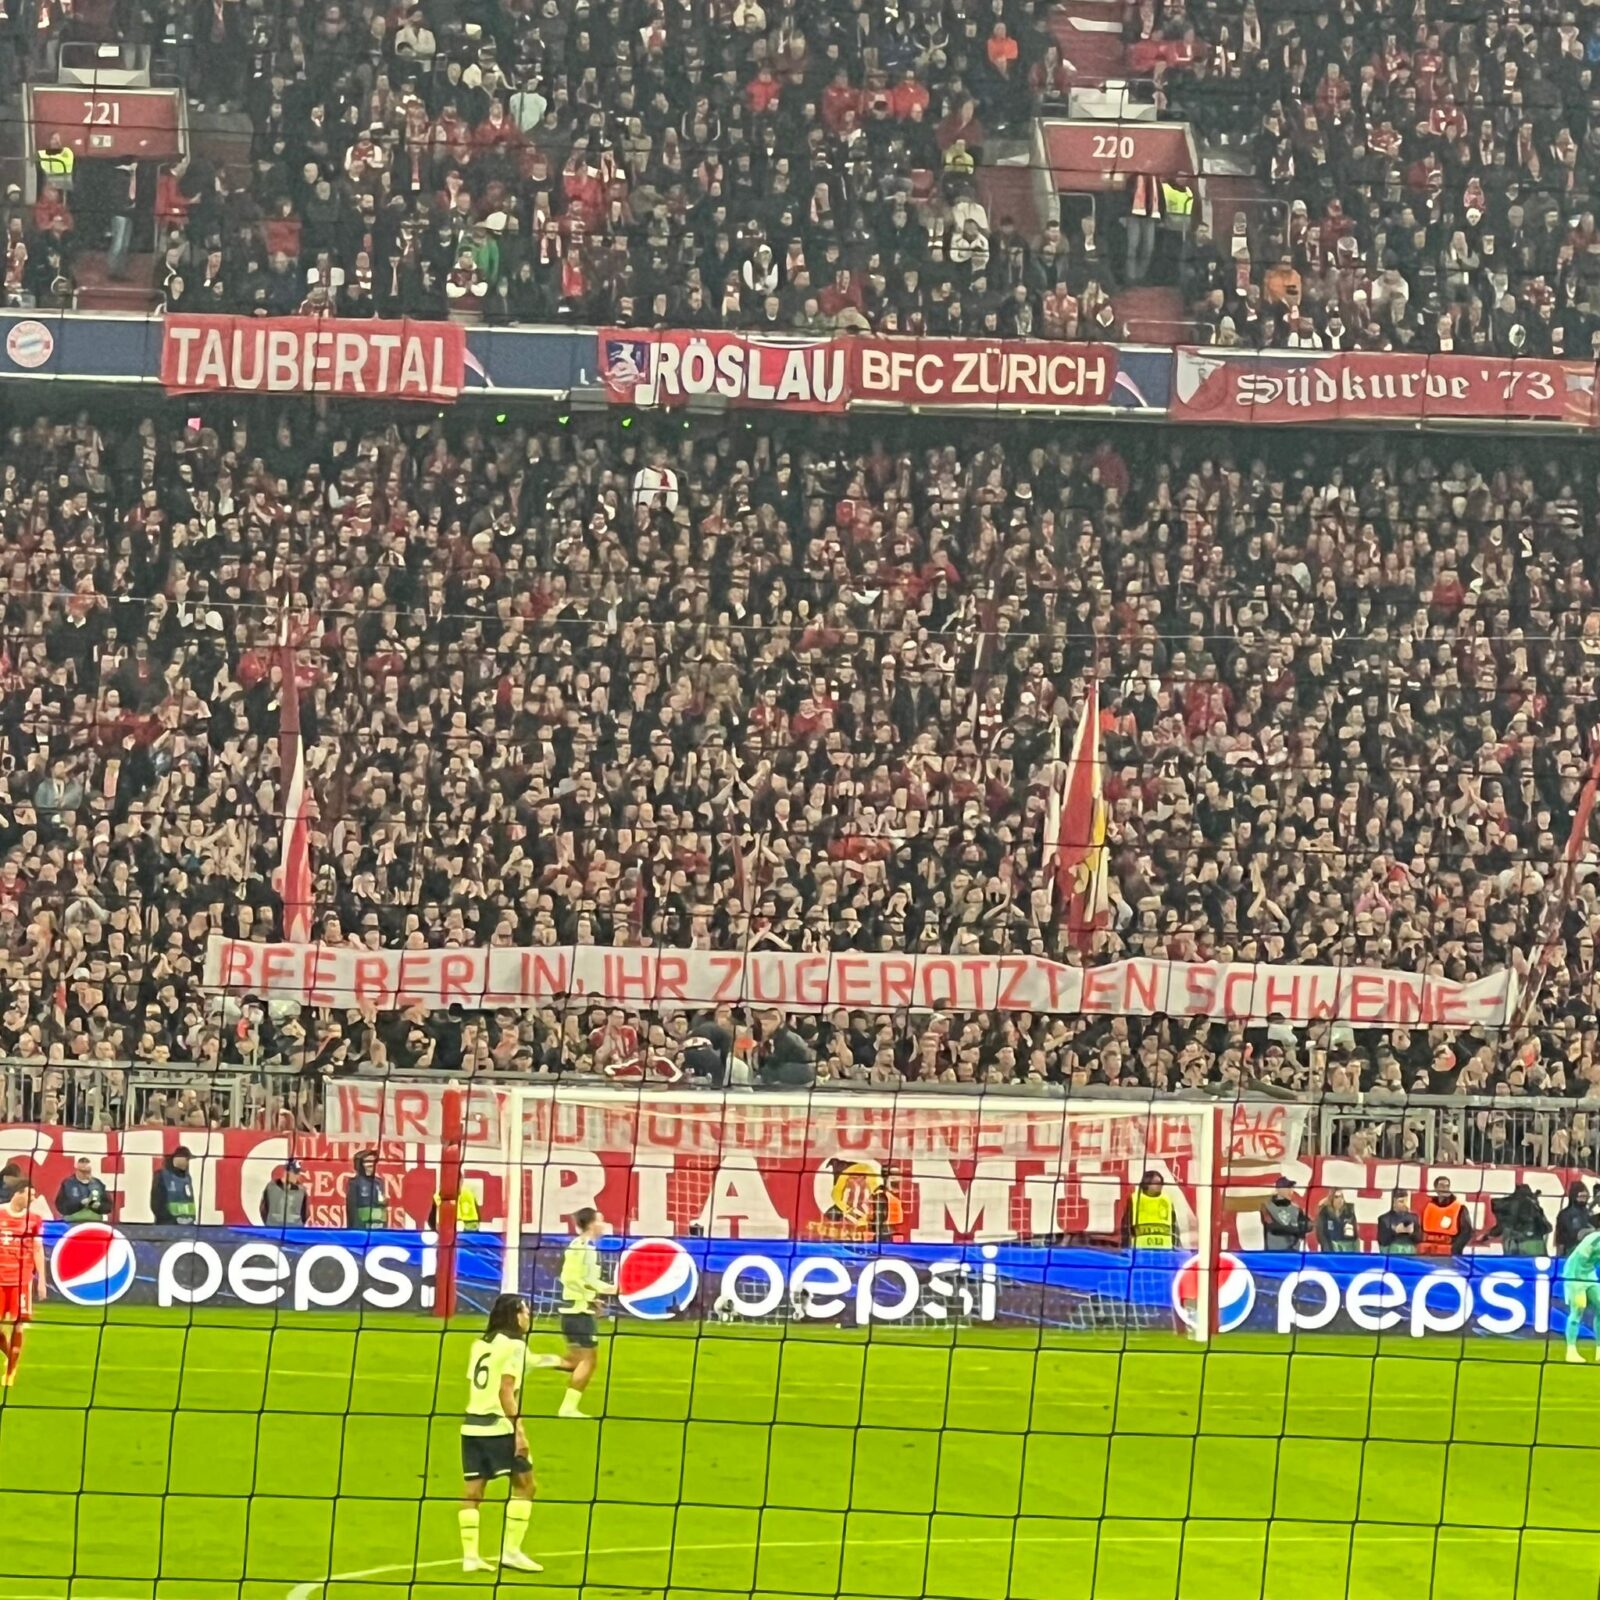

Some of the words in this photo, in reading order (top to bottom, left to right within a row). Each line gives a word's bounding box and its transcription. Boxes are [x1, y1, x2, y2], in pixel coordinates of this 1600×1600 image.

[83, 102, 119, 125] 221
[1092, 136, 1134, 159] 220
[169, 327, 458, 396] TAUBERTAL
[862, 349, 944, 394] BFC
[951, 347, 1105, 395] ZÜRICH
[1235, 367, 1470, 406] Südkurve
[603, 954, 691, 1001] IHR
[336, 1084, 430, 1137] IHR
[158, 1231, 438, 1311] pepsi
[1277, 1256, 1550, 1337] pepsi
[473, 1352, 491, 1390] 6
